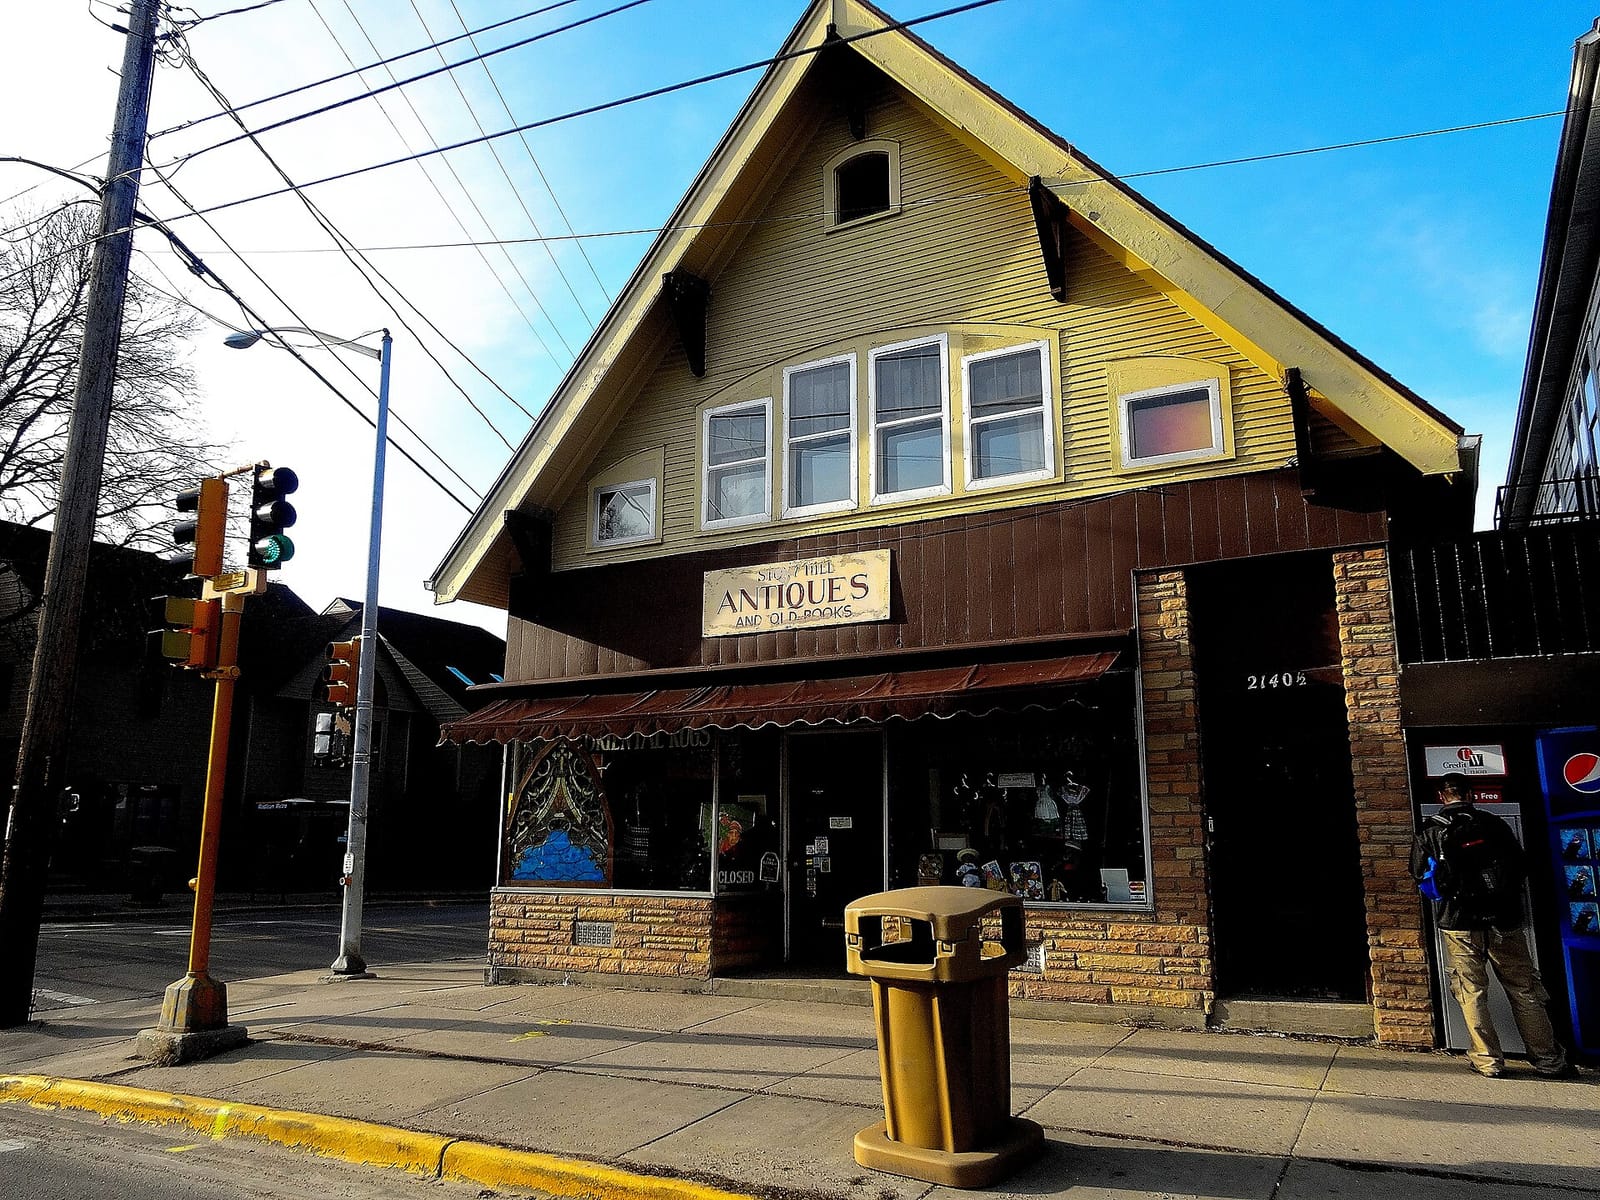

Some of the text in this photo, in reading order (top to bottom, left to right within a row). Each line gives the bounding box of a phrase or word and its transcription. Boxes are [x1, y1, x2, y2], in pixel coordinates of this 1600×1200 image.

[717, 573, 869, 614] ANTIQUES
[736, 614, 762, 628] AND
[1442, 761, 1467, 769] Credit
[1480, 792, 1498, 800] Free
[718, 870, 754, 884] CLOSED
